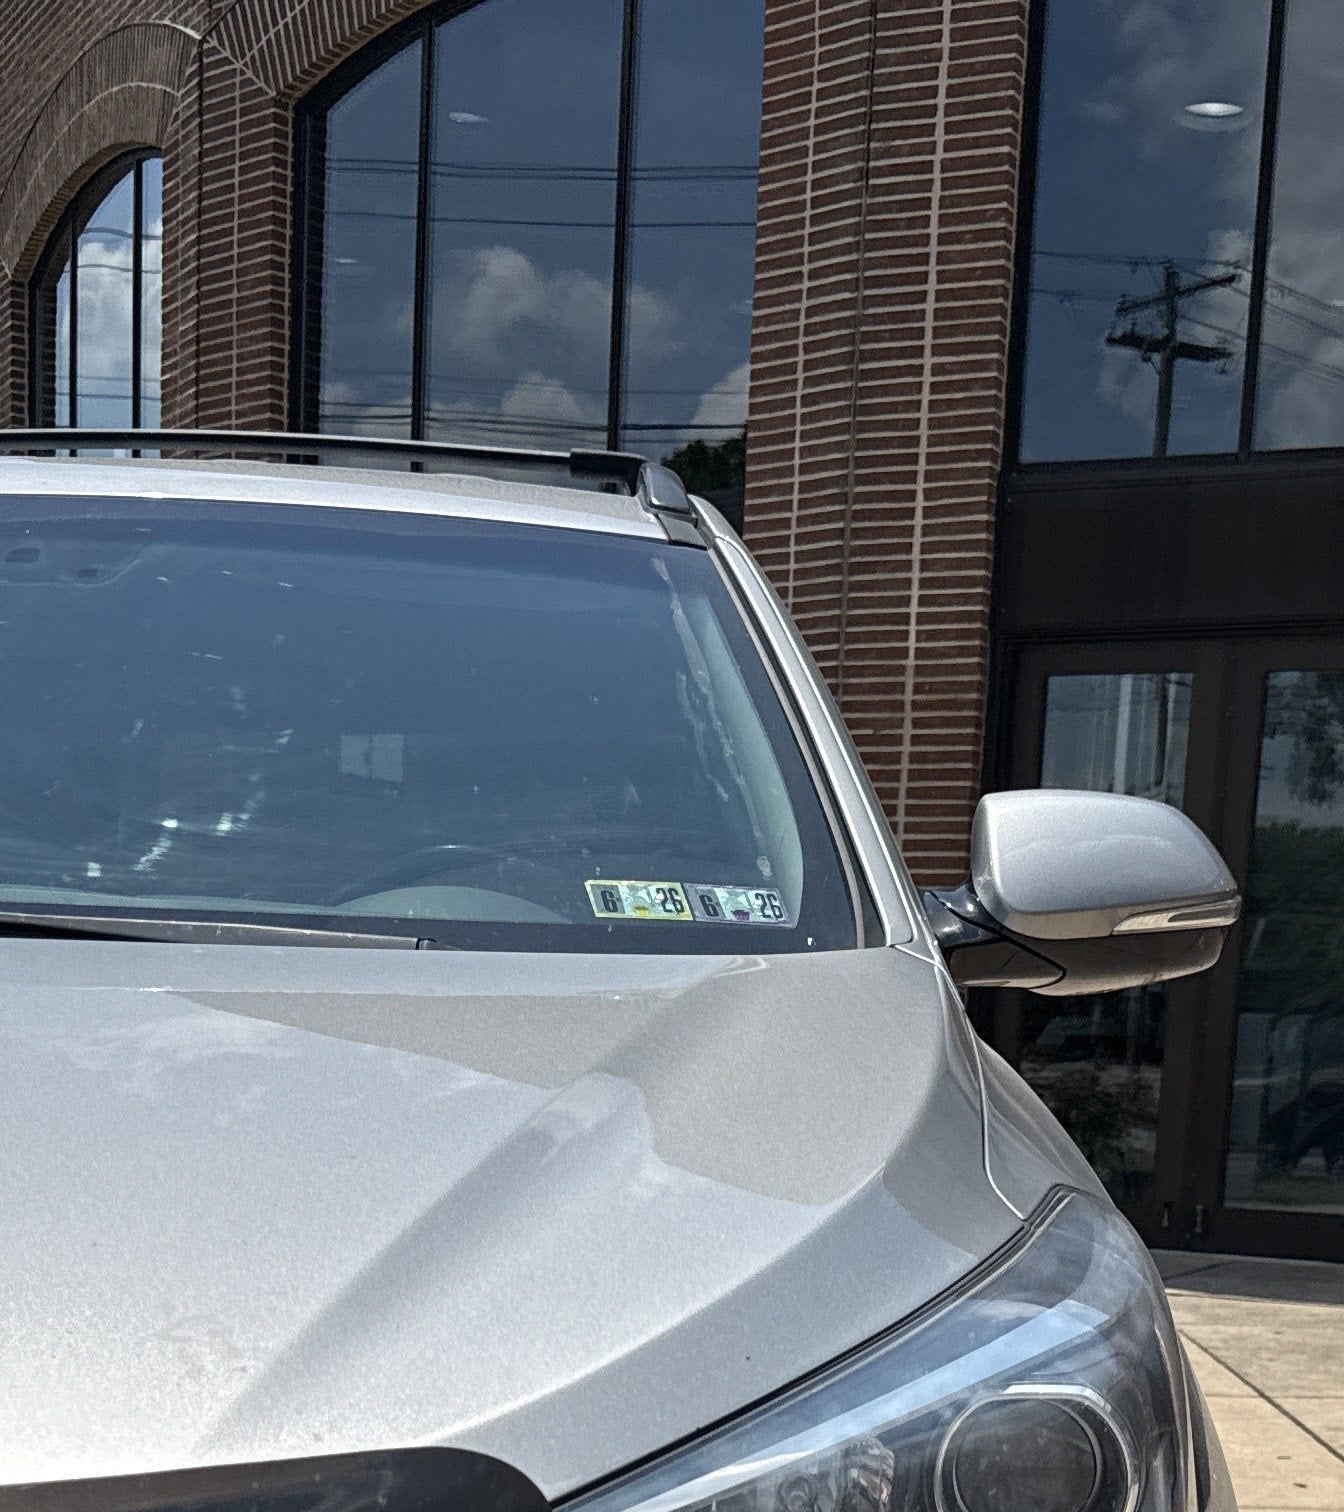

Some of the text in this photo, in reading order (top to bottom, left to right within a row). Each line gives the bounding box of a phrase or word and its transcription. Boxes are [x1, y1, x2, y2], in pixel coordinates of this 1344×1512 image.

[600, 887, 684, 913] 6 26
[699, 892, 784, 919] 6 26
